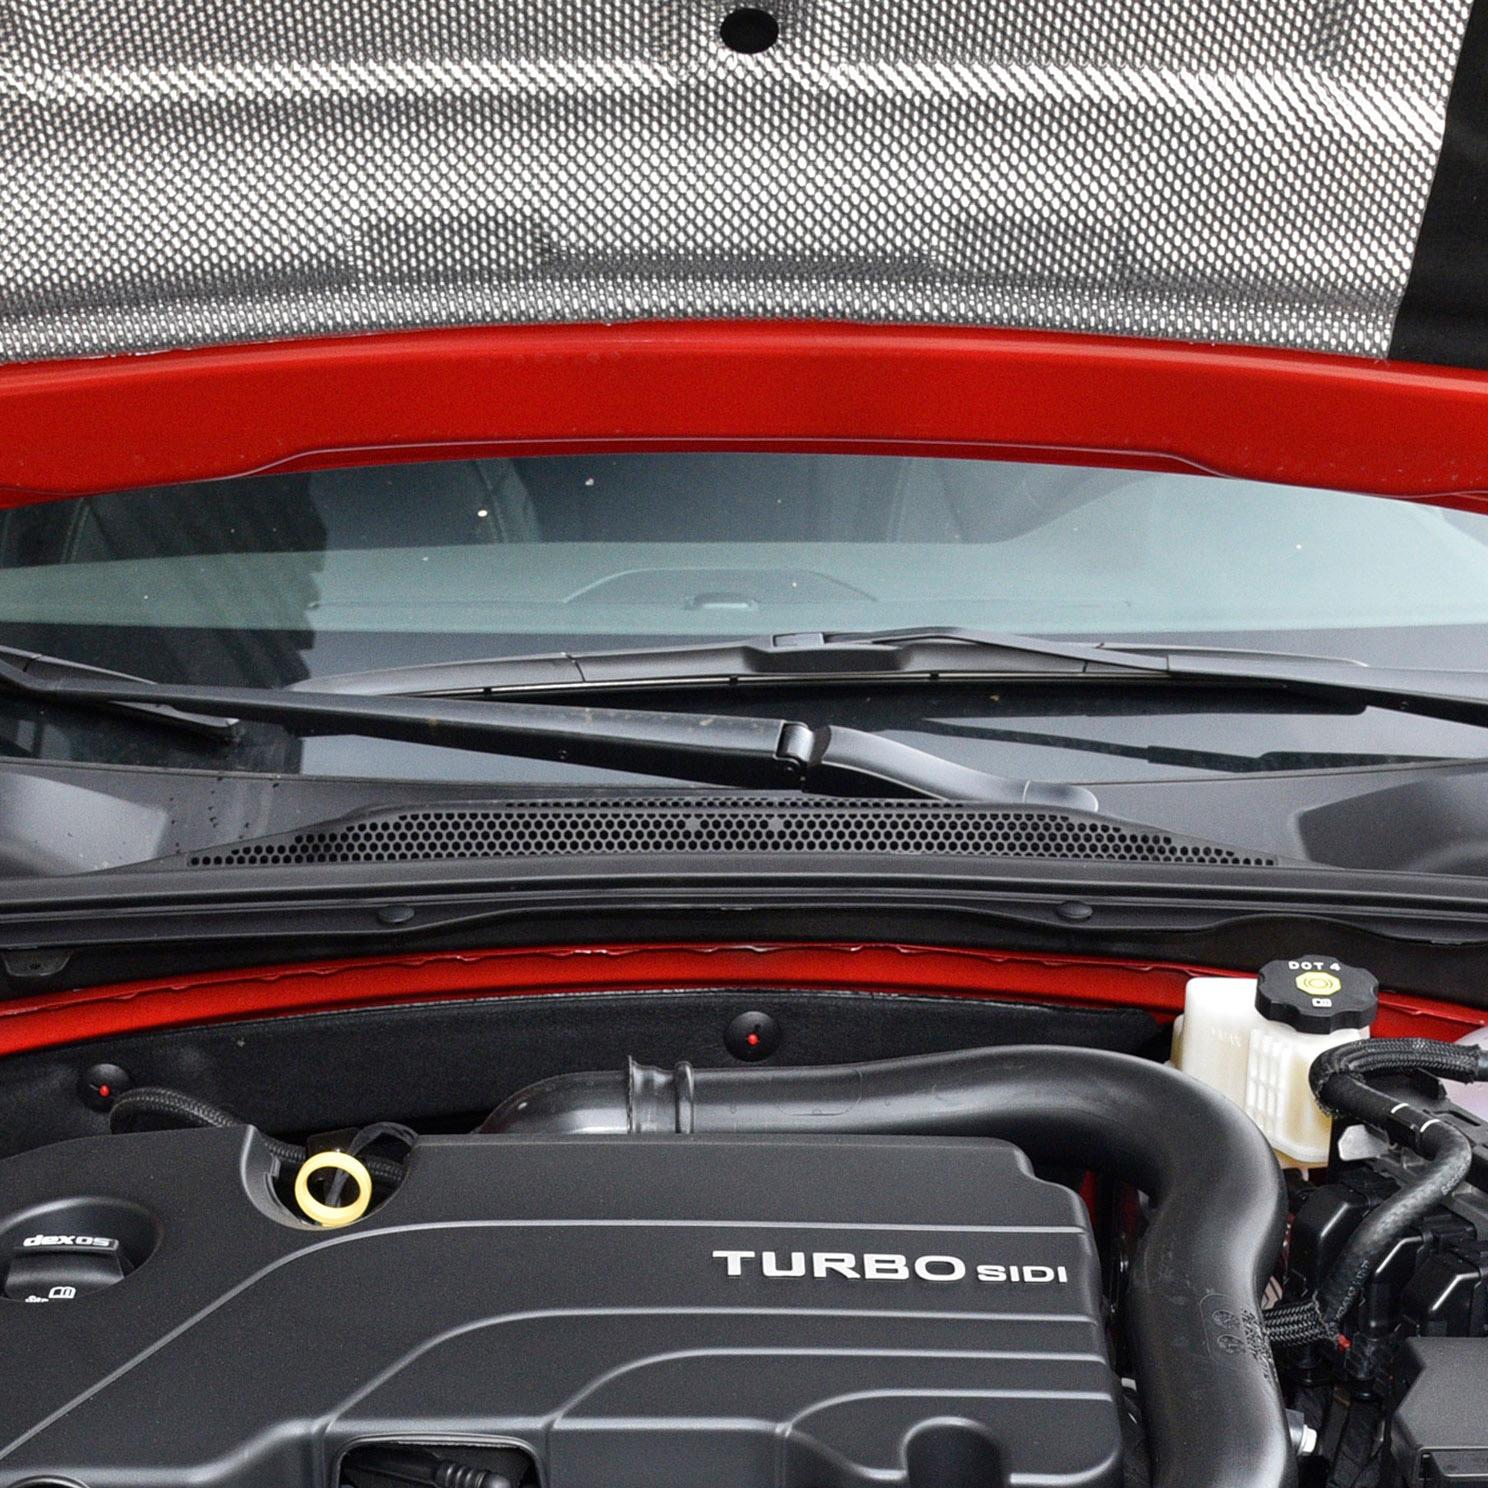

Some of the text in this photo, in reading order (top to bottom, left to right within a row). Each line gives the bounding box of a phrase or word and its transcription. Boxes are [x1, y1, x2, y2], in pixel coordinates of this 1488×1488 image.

[1289, 961, 1341, 971] DOT 4
[23, 1235, 111, 1247] dexos
[712, 1250, 1068, 1283] TURBO SIDI
